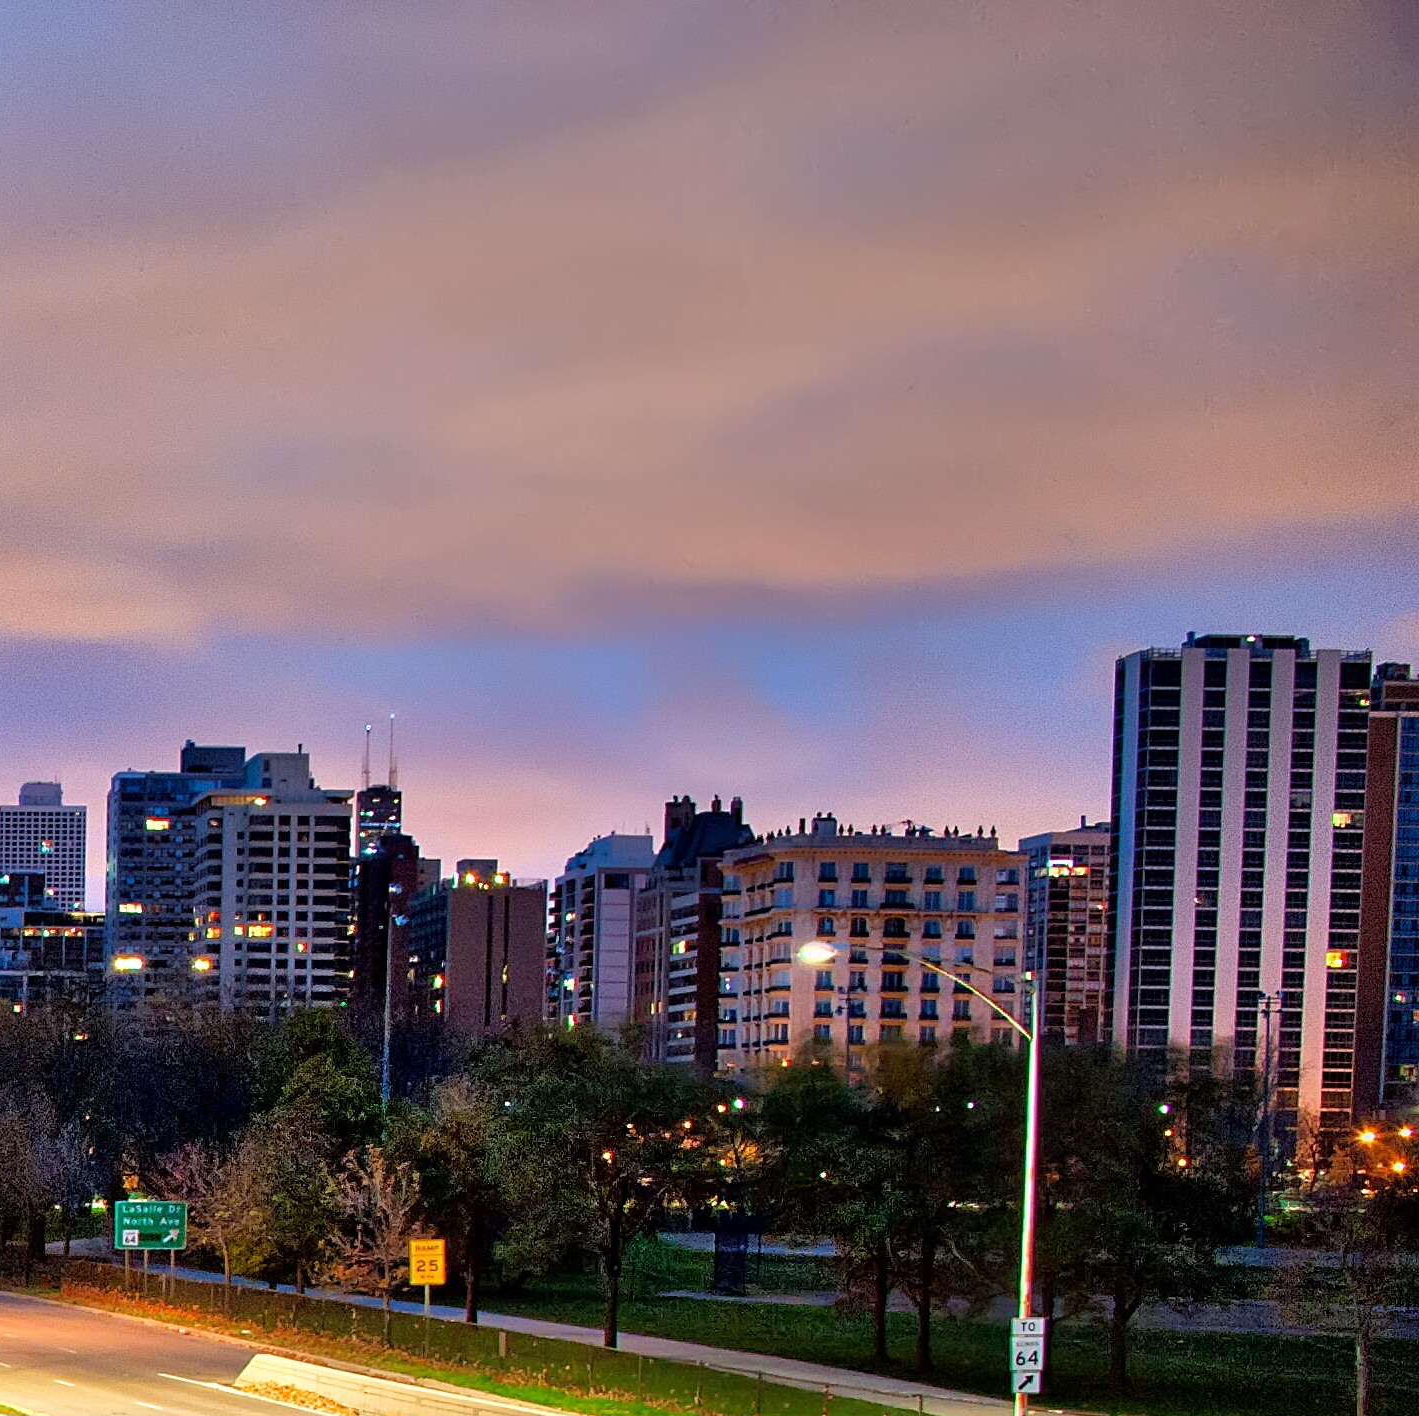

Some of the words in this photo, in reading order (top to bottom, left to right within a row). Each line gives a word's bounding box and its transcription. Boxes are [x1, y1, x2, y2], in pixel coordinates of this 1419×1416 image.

[123, 1205, 163, 1214] LaSalle
[168, 1205, 182, 1214] Dr
[123, 1217, 154, 1226] North
[159, 1217, 180, 1226] Ave
[416, 1259, 439, 1272] 25
[1021, 1322, 1036, 1332] TO
[1015, 1350, 1039, 1366] 64
